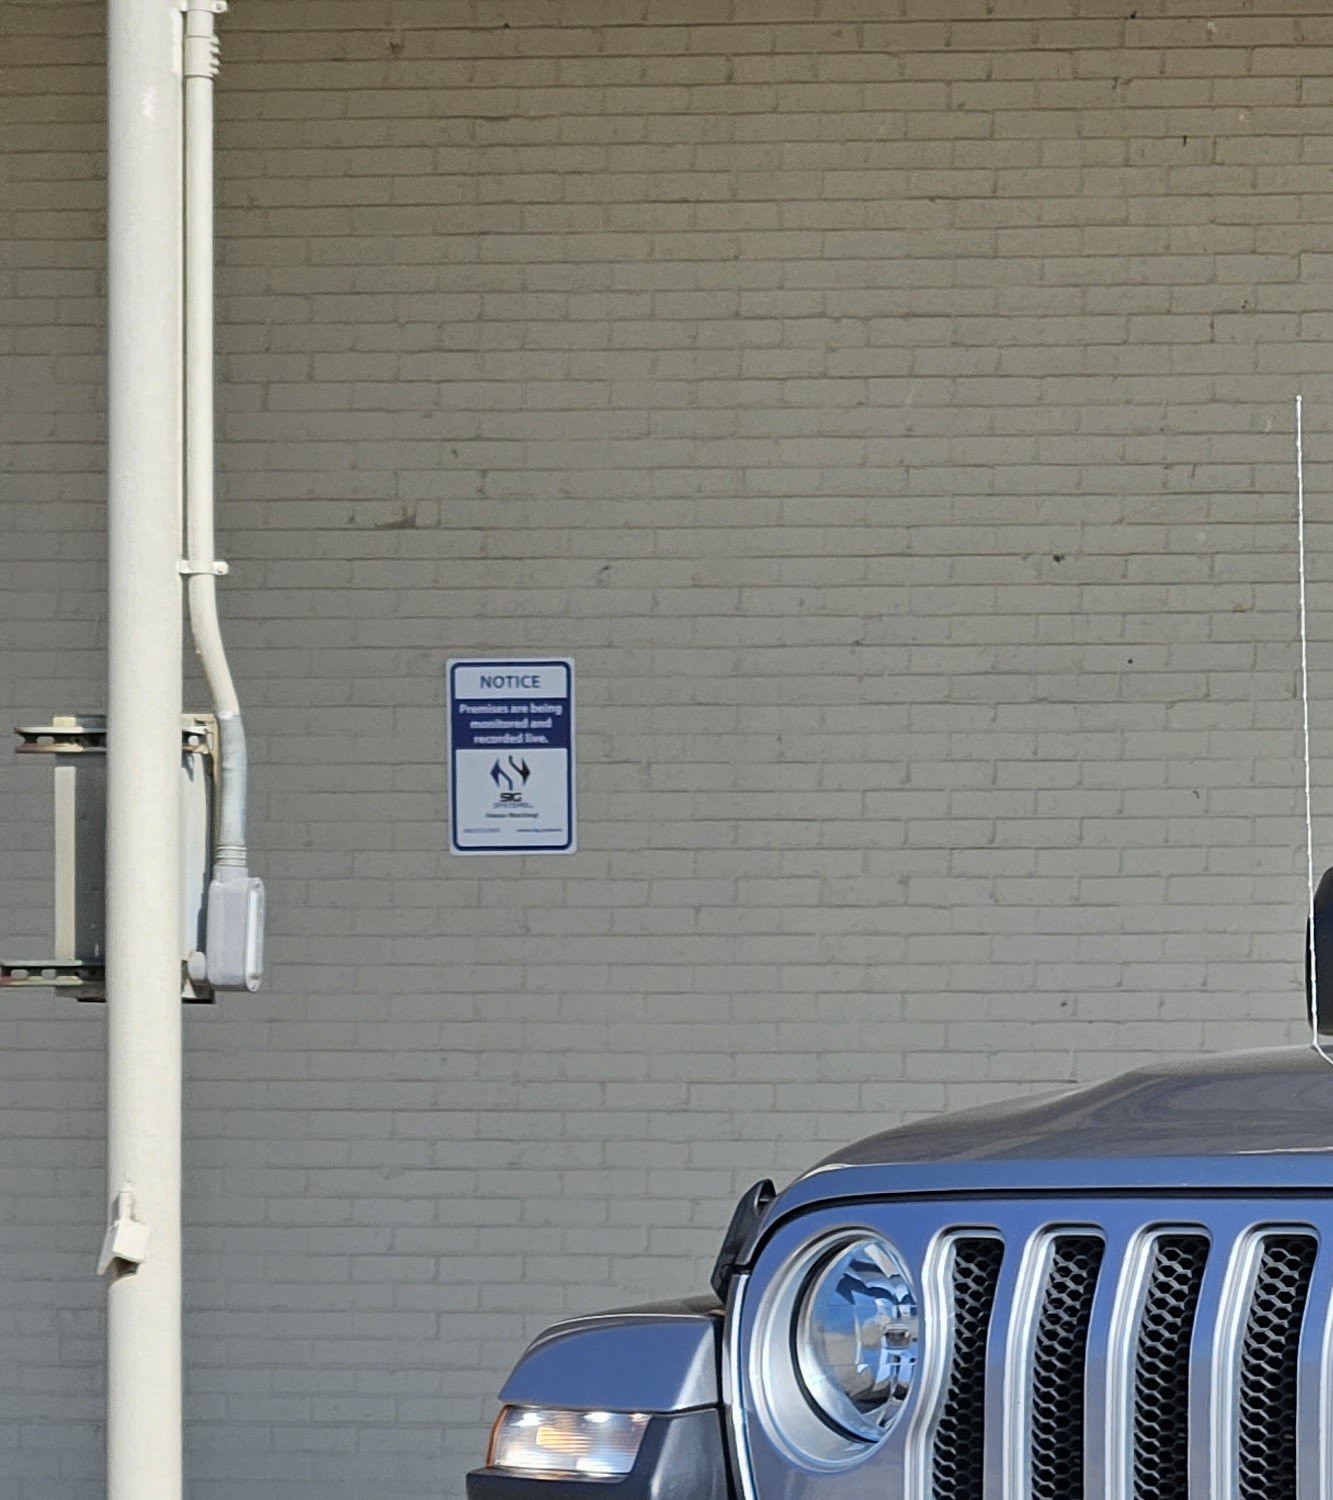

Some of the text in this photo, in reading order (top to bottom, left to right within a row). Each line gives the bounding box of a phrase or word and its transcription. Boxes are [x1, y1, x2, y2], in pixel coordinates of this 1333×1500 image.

[480, 675, 541, 689] NOTICE
[459, 702, 562, 715] Premises are being
[469, 717, 552, 729] monitored and
[473, 733, 523, 744] recorded
